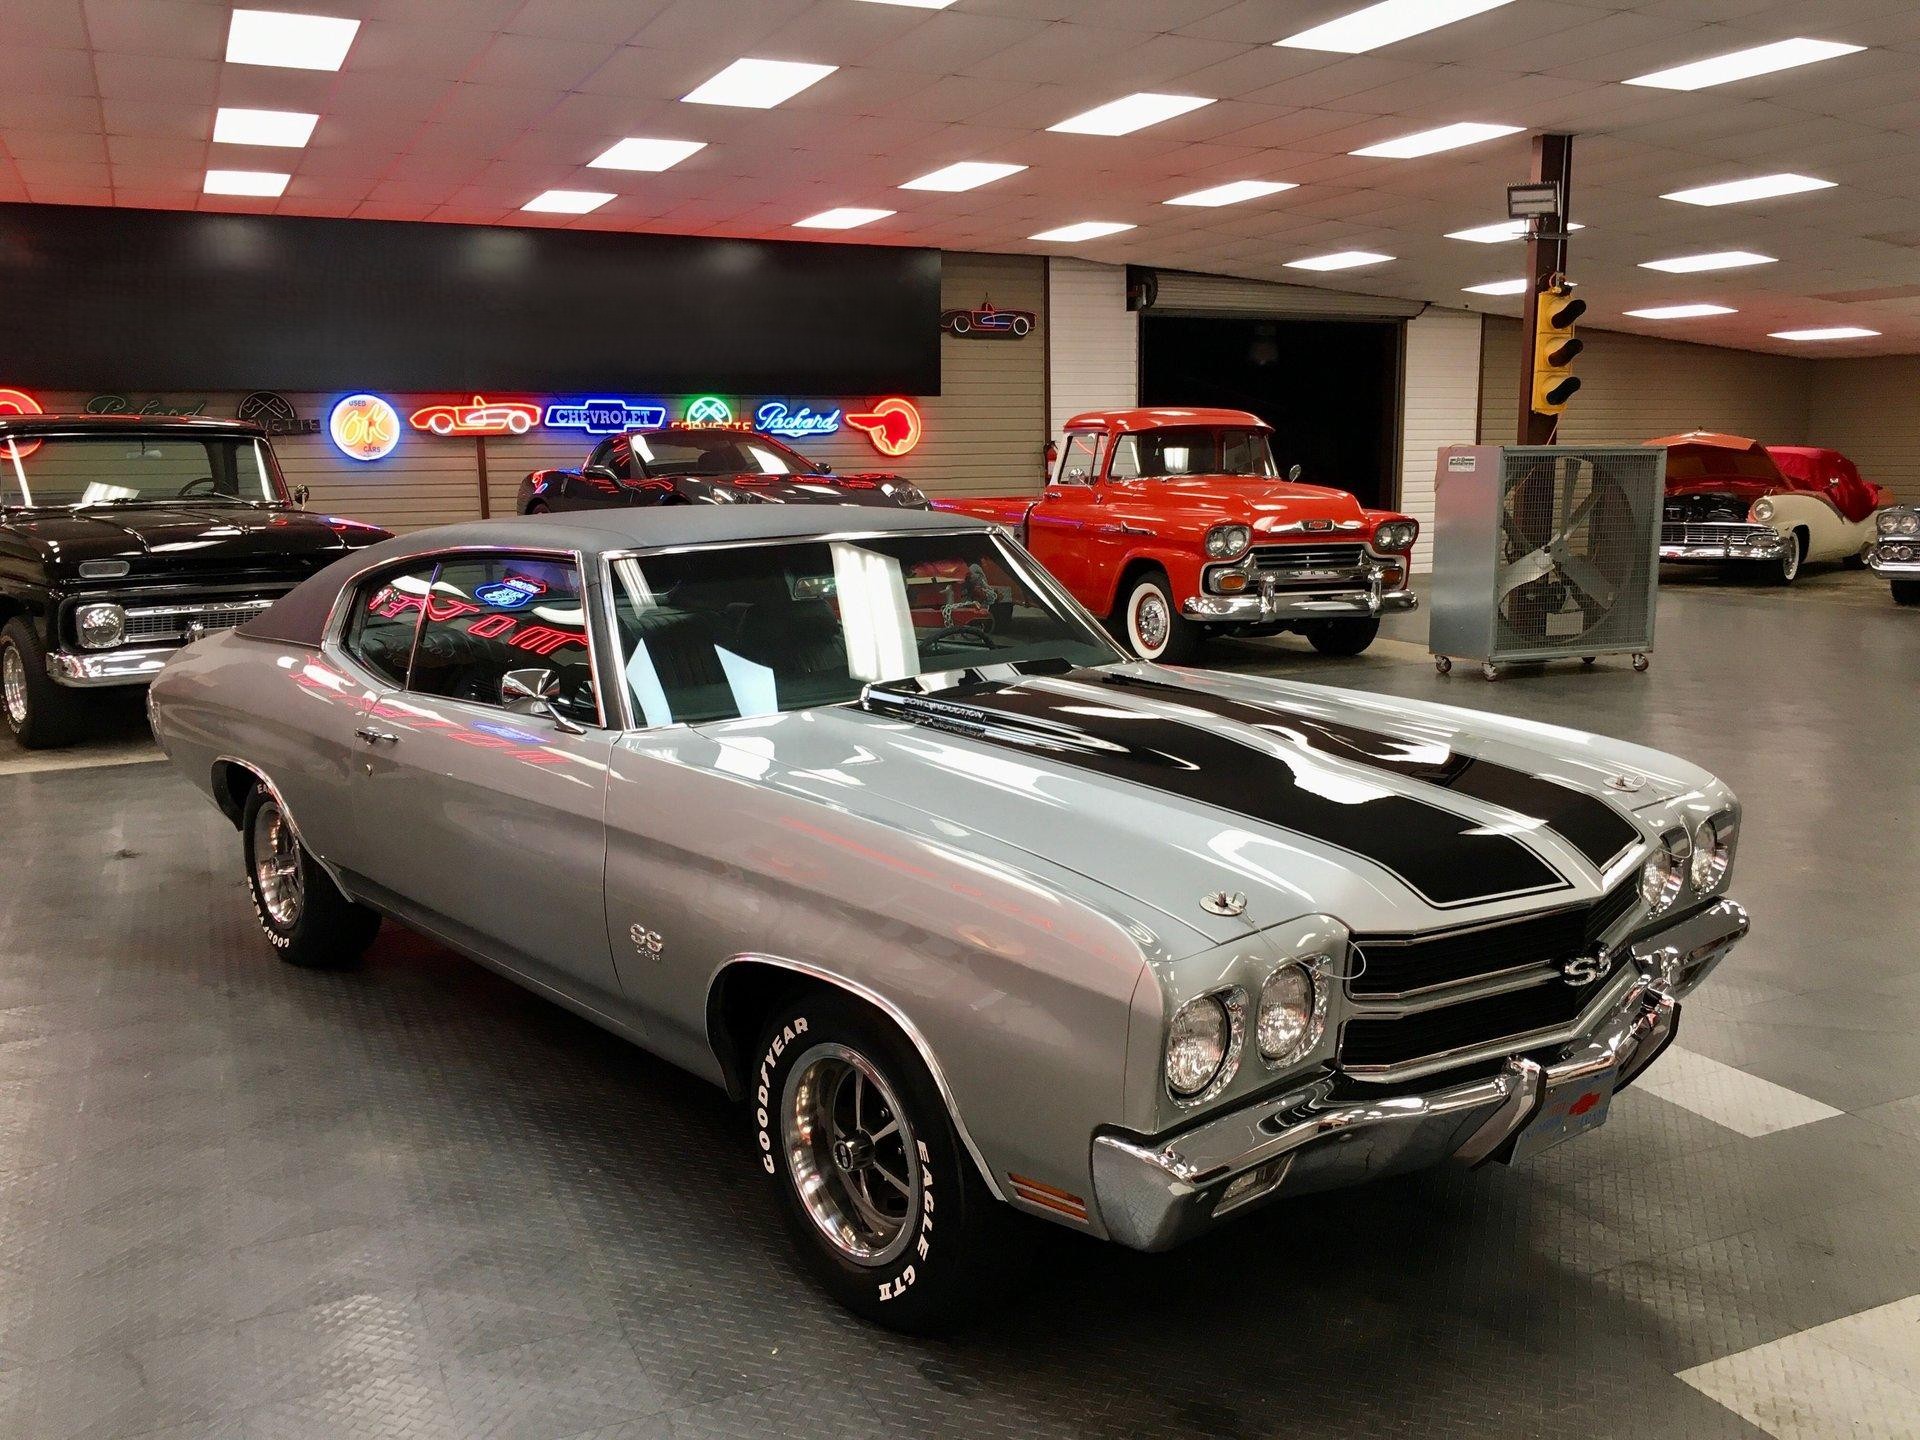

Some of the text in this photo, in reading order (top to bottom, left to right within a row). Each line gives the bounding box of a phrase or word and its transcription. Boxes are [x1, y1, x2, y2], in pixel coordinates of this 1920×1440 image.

[348, 400, 367, 408] USED
[556, 409, 651, 425] CHEVROLET
[755, 402, 841, 435] Packard
[339, 402, 391, 447] OK
[363, 446, 382, 454] CARS
[630, 923, 662, 952] SS
[757, 1016, 809, 1174] GOODYEAR
[916, 1139, 935, 1262] EAGLE
